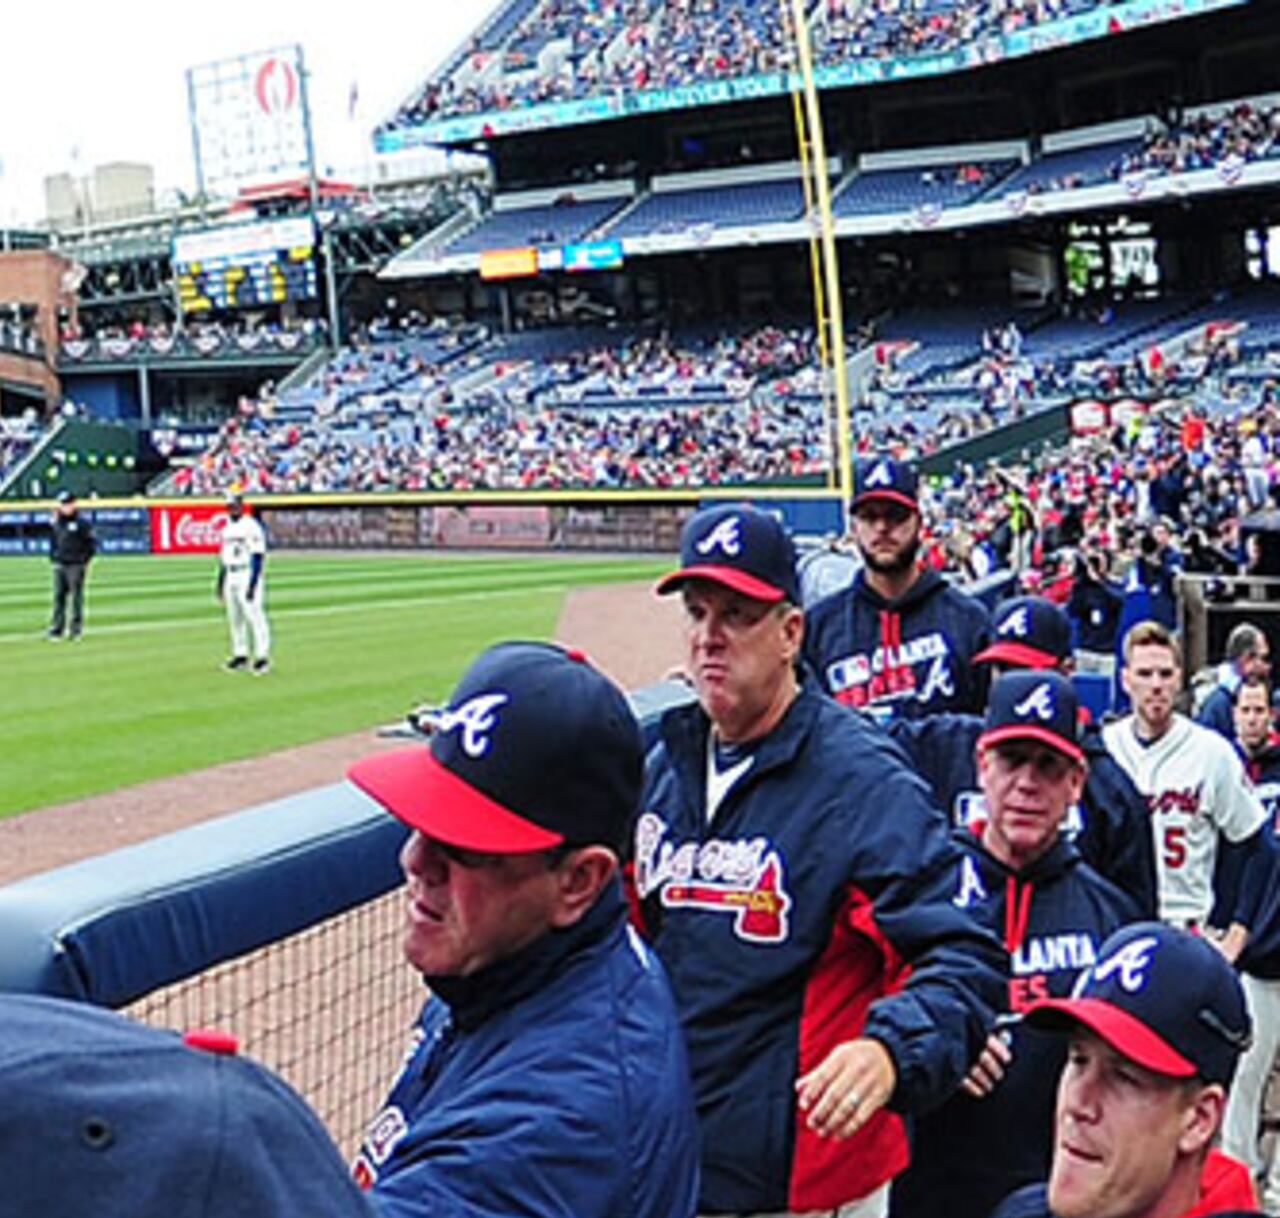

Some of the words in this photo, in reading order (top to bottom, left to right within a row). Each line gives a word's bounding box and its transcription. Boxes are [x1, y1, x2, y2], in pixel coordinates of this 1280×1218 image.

[696, 516, 741, 556] A
[997, 606, 1028, 635] A
[1014, 682, 1055, 720] A
[437, 692, 509, 758] A
[635, 812, 769, 899] Braves
[1163, 826, 1186, 869] 5
[1095, 936, 1159, 992] A
